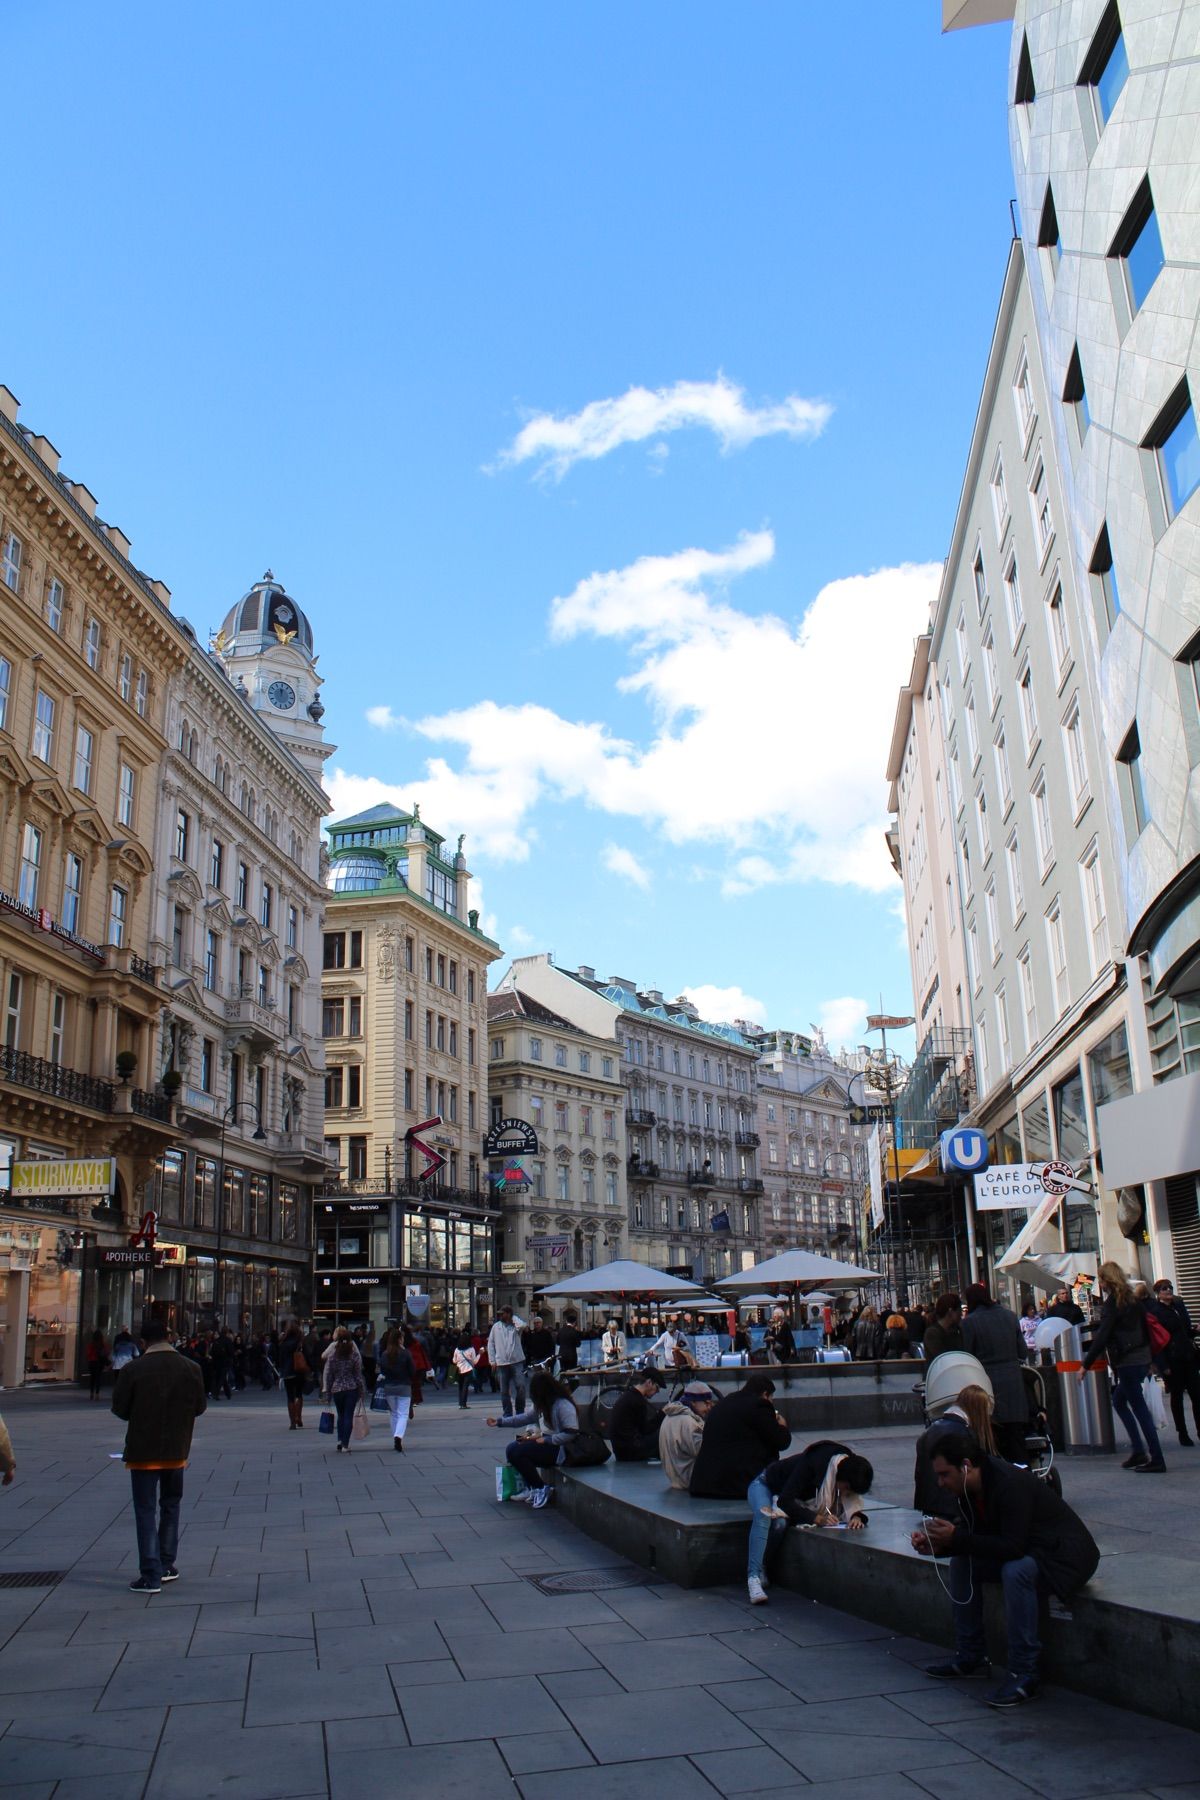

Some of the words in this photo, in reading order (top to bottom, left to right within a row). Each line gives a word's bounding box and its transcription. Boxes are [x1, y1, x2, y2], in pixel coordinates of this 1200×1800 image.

[497, 1140, 527, 1149] BUFFET
[953, 1136, 981, 1166] U
[19, 1162, 105, 1187] STURMAYR
[985, 1170, 1020, 1183] CAFÉ
[17, 1186, 104, 1194] COIFFEURE
[980, 1184, 1043, 1197] L'EUROP
[105, 1251, 152, 1262] APOTHEKE
[349, 1277, 380, 1285] NESPRESSO
